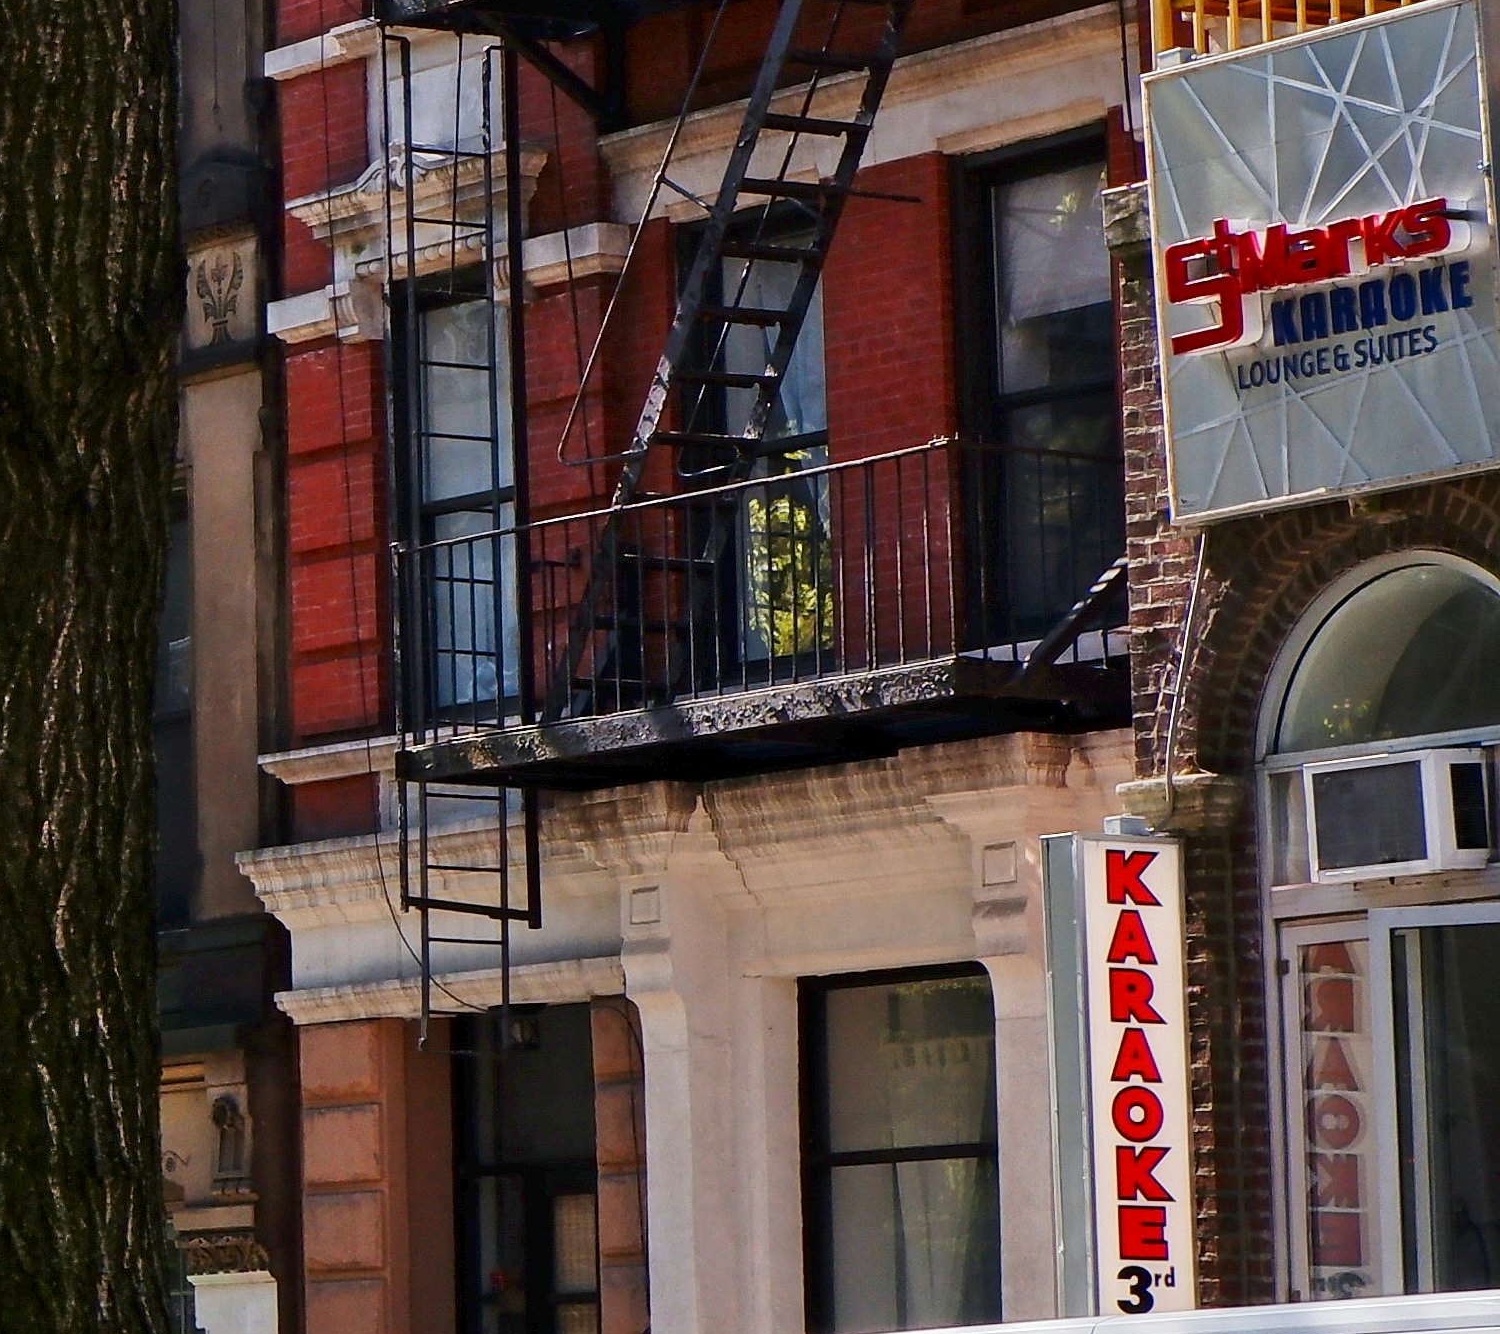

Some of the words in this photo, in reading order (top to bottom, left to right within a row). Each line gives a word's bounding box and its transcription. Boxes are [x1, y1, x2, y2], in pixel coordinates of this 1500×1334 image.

[1270, 259, 1475, 347] KARAOKE
[1237, 348, 1331, 390] LOUNGE
[1333, 347, 1351, 372] &
[1354, 324, 1439, 367] SUITES
[1105, 848, 1177, 1262] KARAOKE
[1116, 1265, 1176, 1315] 3rd
